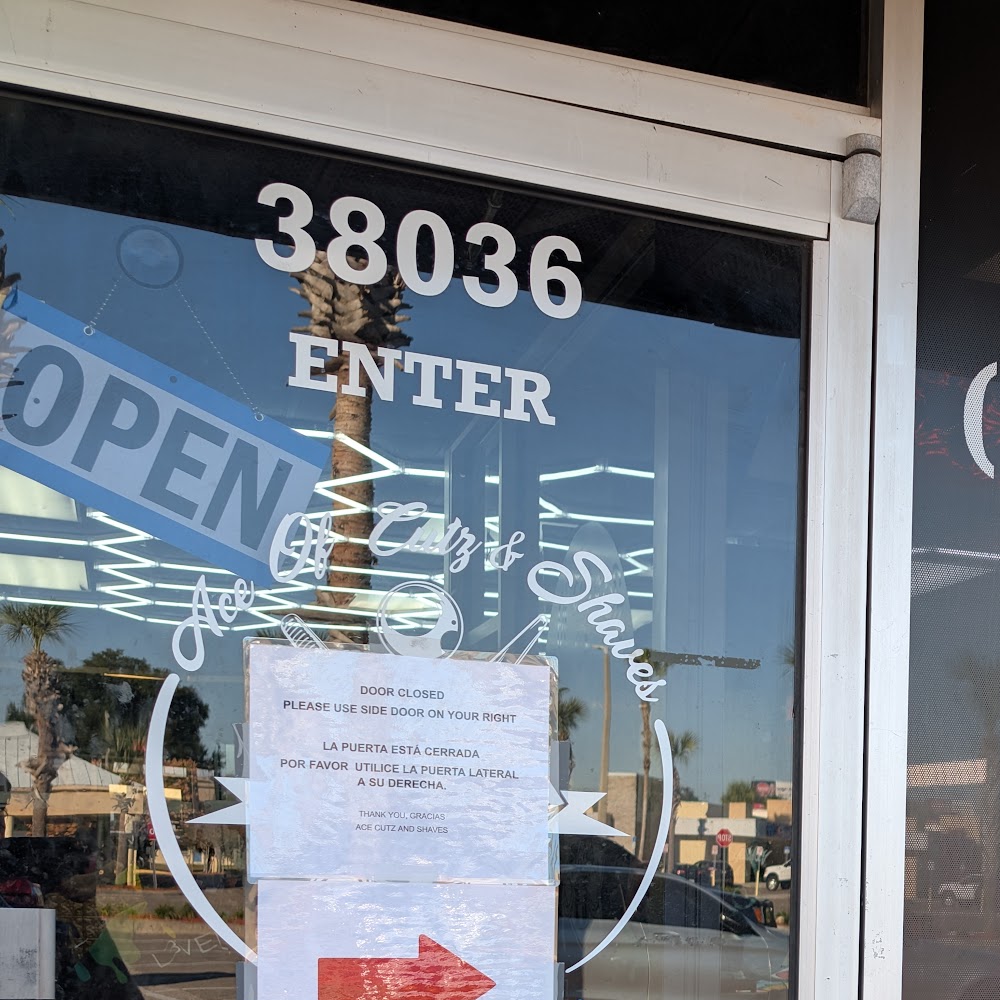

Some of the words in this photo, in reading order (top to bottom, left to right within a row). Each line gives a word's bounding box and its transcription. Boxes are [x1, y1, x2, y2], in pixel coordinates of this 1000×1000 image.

[255, 182, 583, 319] 38036
[288, 332, 556, 426] ENTER
[2, 344, 294, 551] OPEN
[171, 574, 254, 671] Ace
[269, 512, 333, 583] Of
[368, 502, 484, 573] Cutz
[489, 531, 525, 571] &
[527, 551, 667, 702] Shaves
[361, 686, 394, 696] DOOR
[398, 688, 445, 699] CLOSED
[283, 701, 330, 712] PLEASE
[334, 703, 357, 713] USE
[361, 705, 387, 716] SIDE
[391, 707, 424, 718] DOOR
[428, 709, 444, 718] ON
[447, 710, 479, 721] YOUR
[483, 712, 516, 723] RIGHT
[323, 742, 338, 751] LA
[342, 743, 387, 754] PUERTA
[391, 744, 421, 755] ESTÁ
[425, 747, 480, 758] CERRADA
[280, 759, 305, 769] POR
[310, 760, 348, 771] FAVOR
[355, 762, 399, 773] UTILICE
[403, 764, 417, 774] LA
[421, 766, 466, 777] PUERTA
[469, 768, 519, 779] LATERAL
[358, 778, 365, 786] A
[369, 779, 385, 787] SU
[388, 779, 446, 790] DERECHA.
[359, 811, 386, 819] THANK
[410, 812, 445, 820] GRACIAS
[356, 824, 372, 832] ACE
[417, 826, 448, 834] SHAVES
